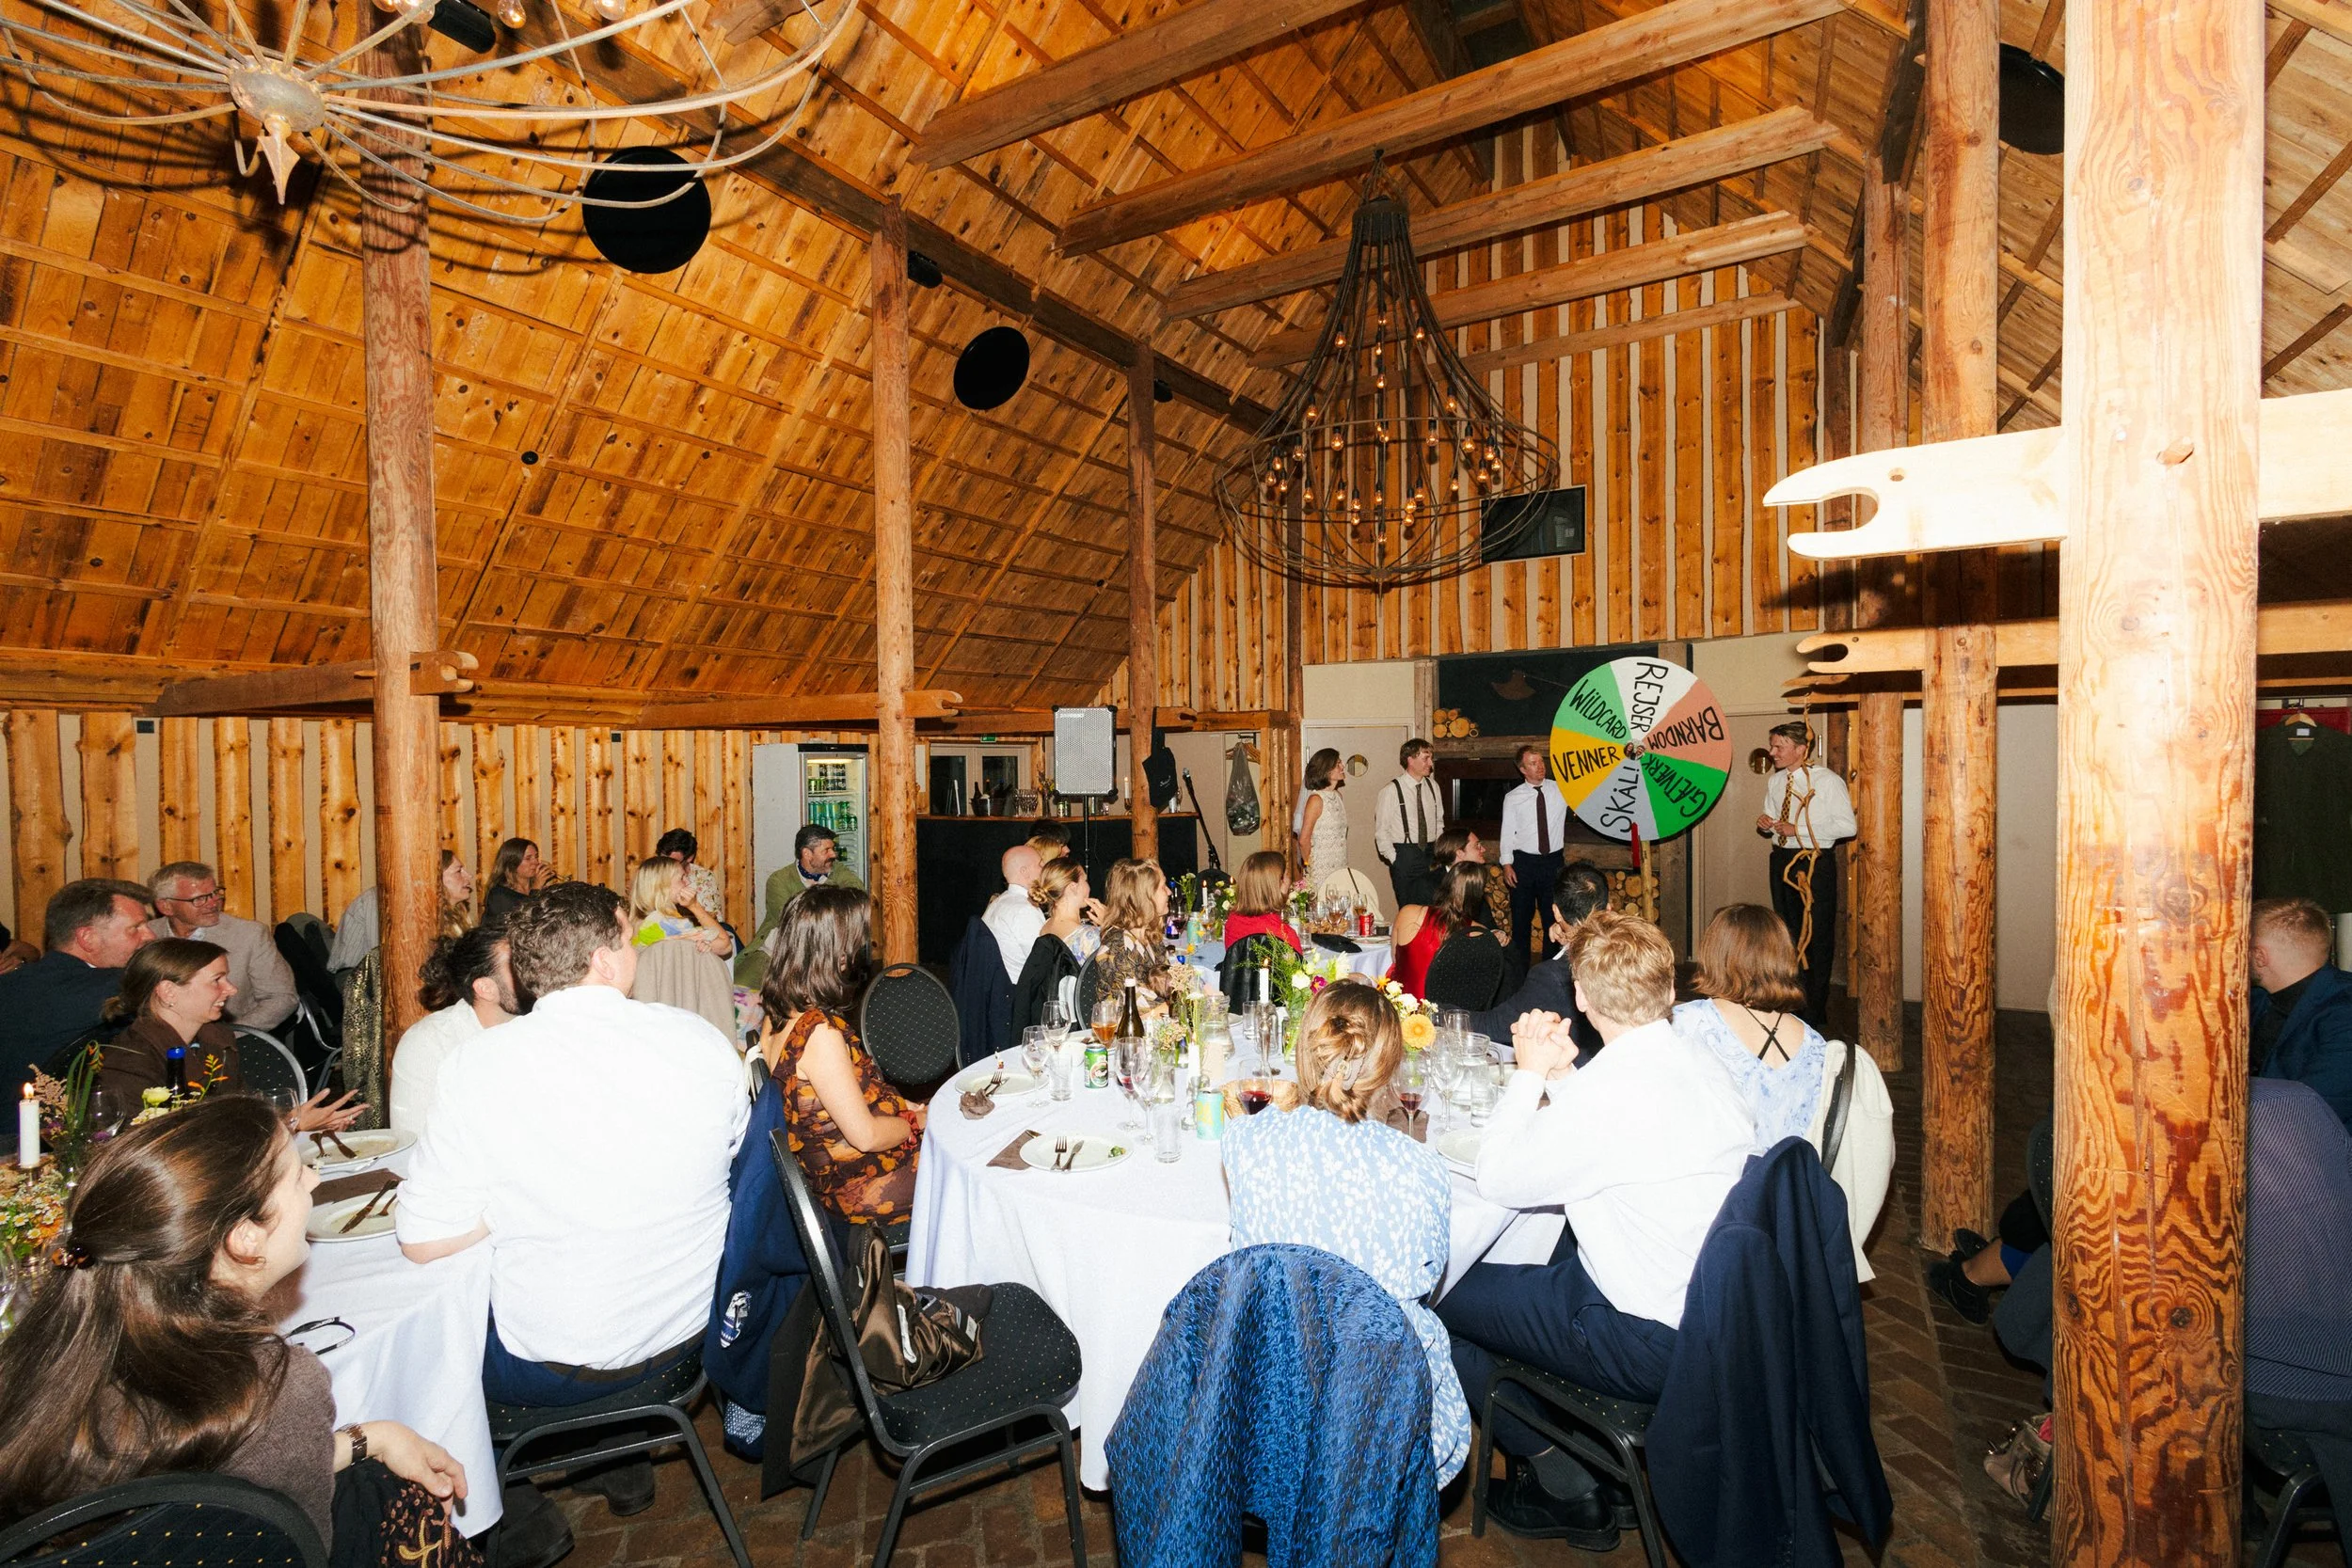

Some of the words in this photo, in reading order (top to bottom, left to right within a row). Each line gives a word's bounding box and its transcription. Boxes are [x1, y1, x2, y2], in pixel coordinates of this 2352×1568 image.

[1630, 661, 1669, 733] REJSER
[1647, 705, 1724, 750] BARNDOM
[1553, 746, 1620, 784] VENNER
[1642, 753, 1708, 818] GÆTVÆRK
